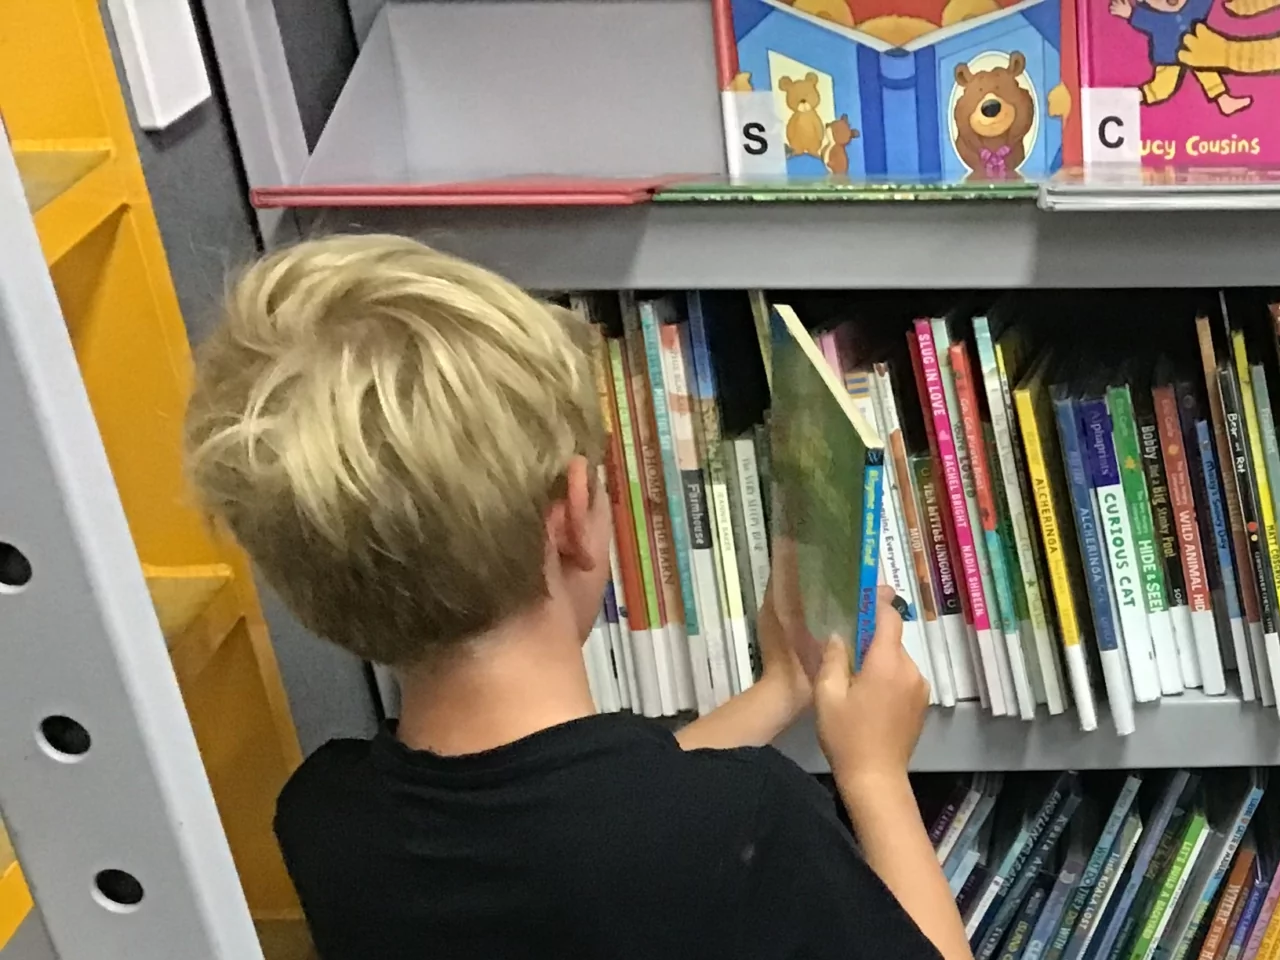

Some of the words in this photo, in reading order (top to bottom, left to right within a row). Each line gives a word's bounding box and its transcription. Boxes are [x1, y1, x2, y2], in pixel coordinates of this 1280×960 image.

[743, 121, 768, 155] S
[1098, 116, 1124, 148] C
[1138, 138, 1175, 160] ucy
[1186, 134, 1260, 156] Cousins
[916, 332, 936, 366] SLUG
[924, 367, 939, 382] IN
[927, 384, 946, 416] LOVE
[1085, 409, 1114, 476] Alphaprints
[1138, 424, 1160, 460] Bobby
[942, 453, 961, 491] RACHEL
[1234, 456, 1246, 473] Rat
[950, 492, 968, 528] BRIGHT
[1149, 485, 1167, 505] Big
[685, 483, 708, 545] Farmhouse
[1032, 477, 1061, 553] ALCHERINGA
[1154, 506, 1171, 534] Stinky
[1178, 510, 1193, 541] WILD
[1077, 506, 1104, 581] ALCHERINGA
[1100, 492, 1131, 569] CURIOUS
[1117, 575, 1136, 608] CAT
[1263, 523, 1279, 546] MATT
[933, 543, 955, 594] UNICORNS
[960, 544, 977, 573] NADIA
[1138, 539, 1156, 572] HIDE
[1184, 543, 1202, 590] ANIMAL
[967, 576, 986, 616] SHIREEN
[1070, 886, 1089, 911] THEY
[1088, 874, 1110, 906] KOALA
[1160, 890, 1170, 898] A
[1214, 882, 1242, 925] WHERE
[1078, 905, 1095, 929] LOST
[1052, 926, 1070, 950] WITH
[1206, 932, 1218, 949] THE
